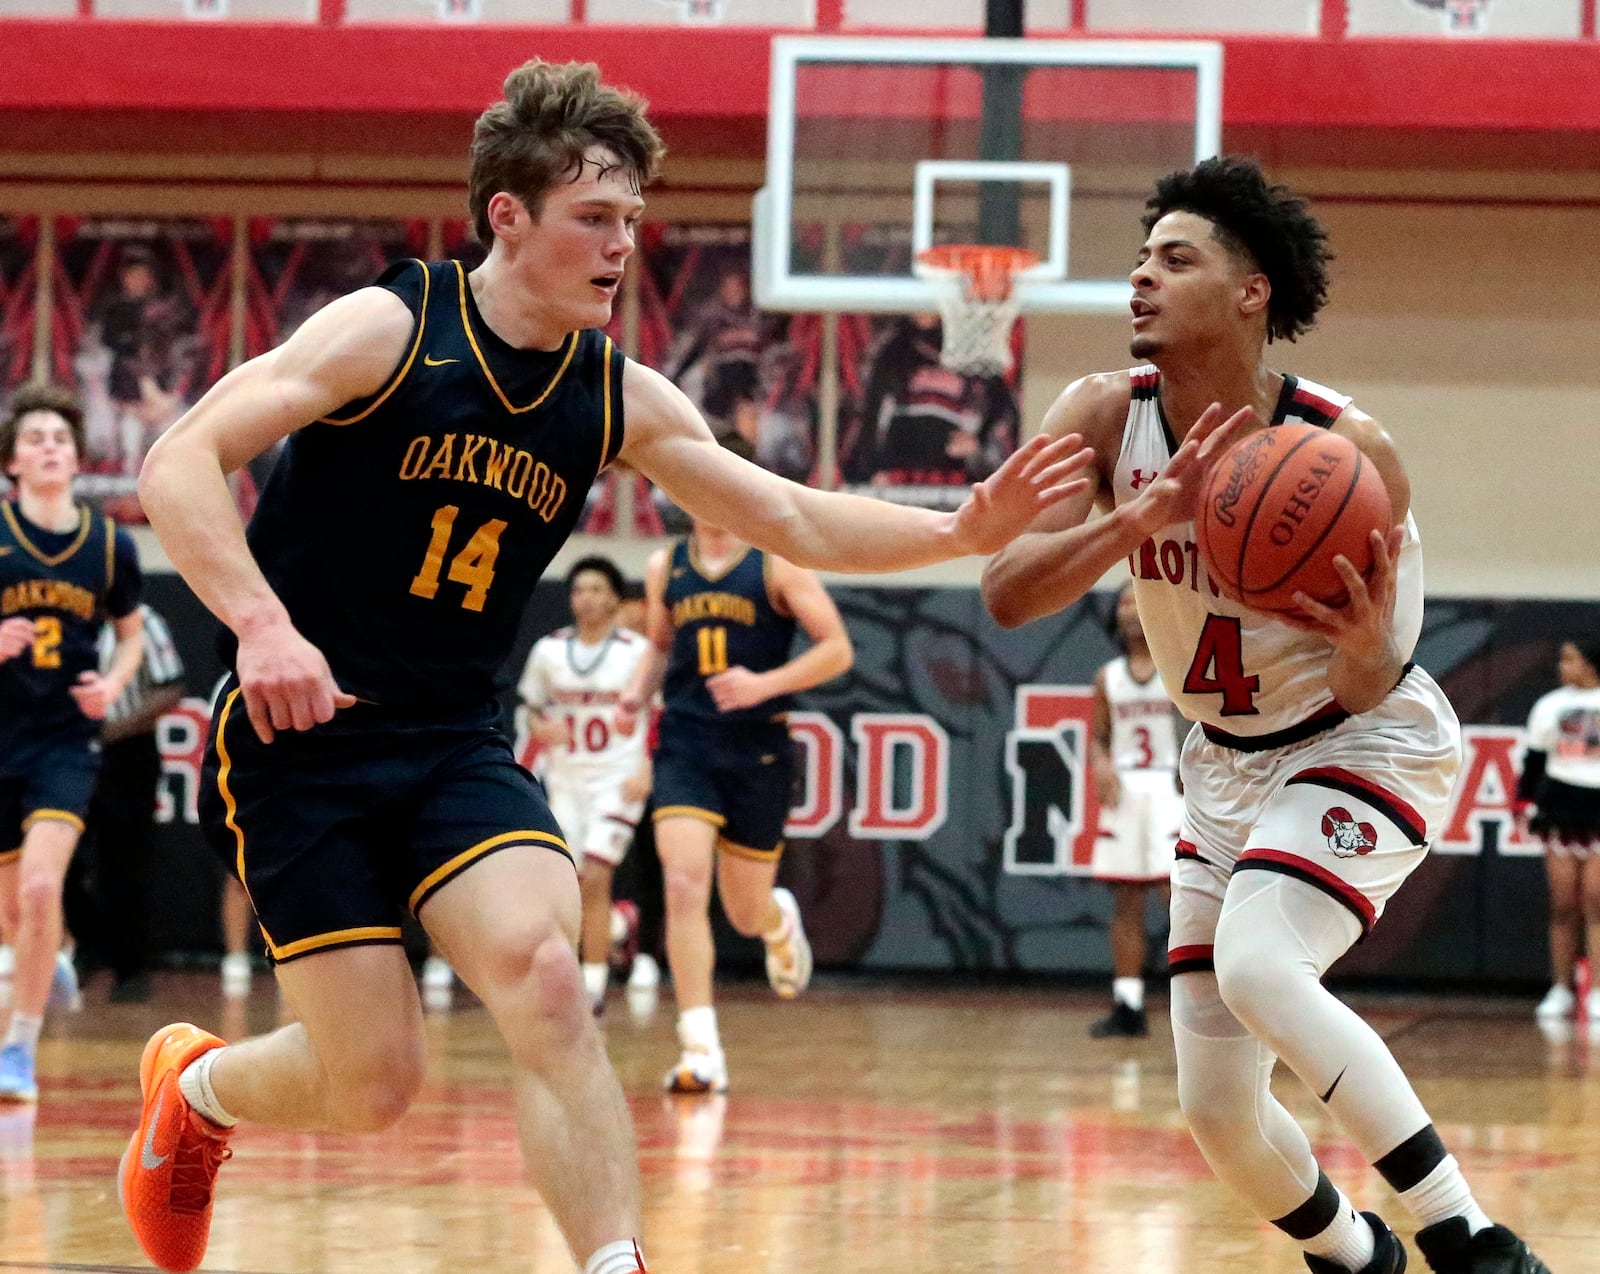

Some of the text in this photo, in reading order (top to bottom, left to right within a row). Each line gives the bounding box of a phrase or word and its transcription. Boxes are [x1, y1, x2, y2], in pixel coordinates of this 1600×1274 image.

[398, 433, 567, 524] OAKWOOD
[1270, 451, 1342, 547] OHSAA
[408, 504, 509, 612] 14
[32, 615, 62, 669] 2
[696, 626, 729, 676] 11
[1183, 611, 1260, 717] 4
[562, 714, 609, 753] 10
[1133, 725, 1154, 769] 3
